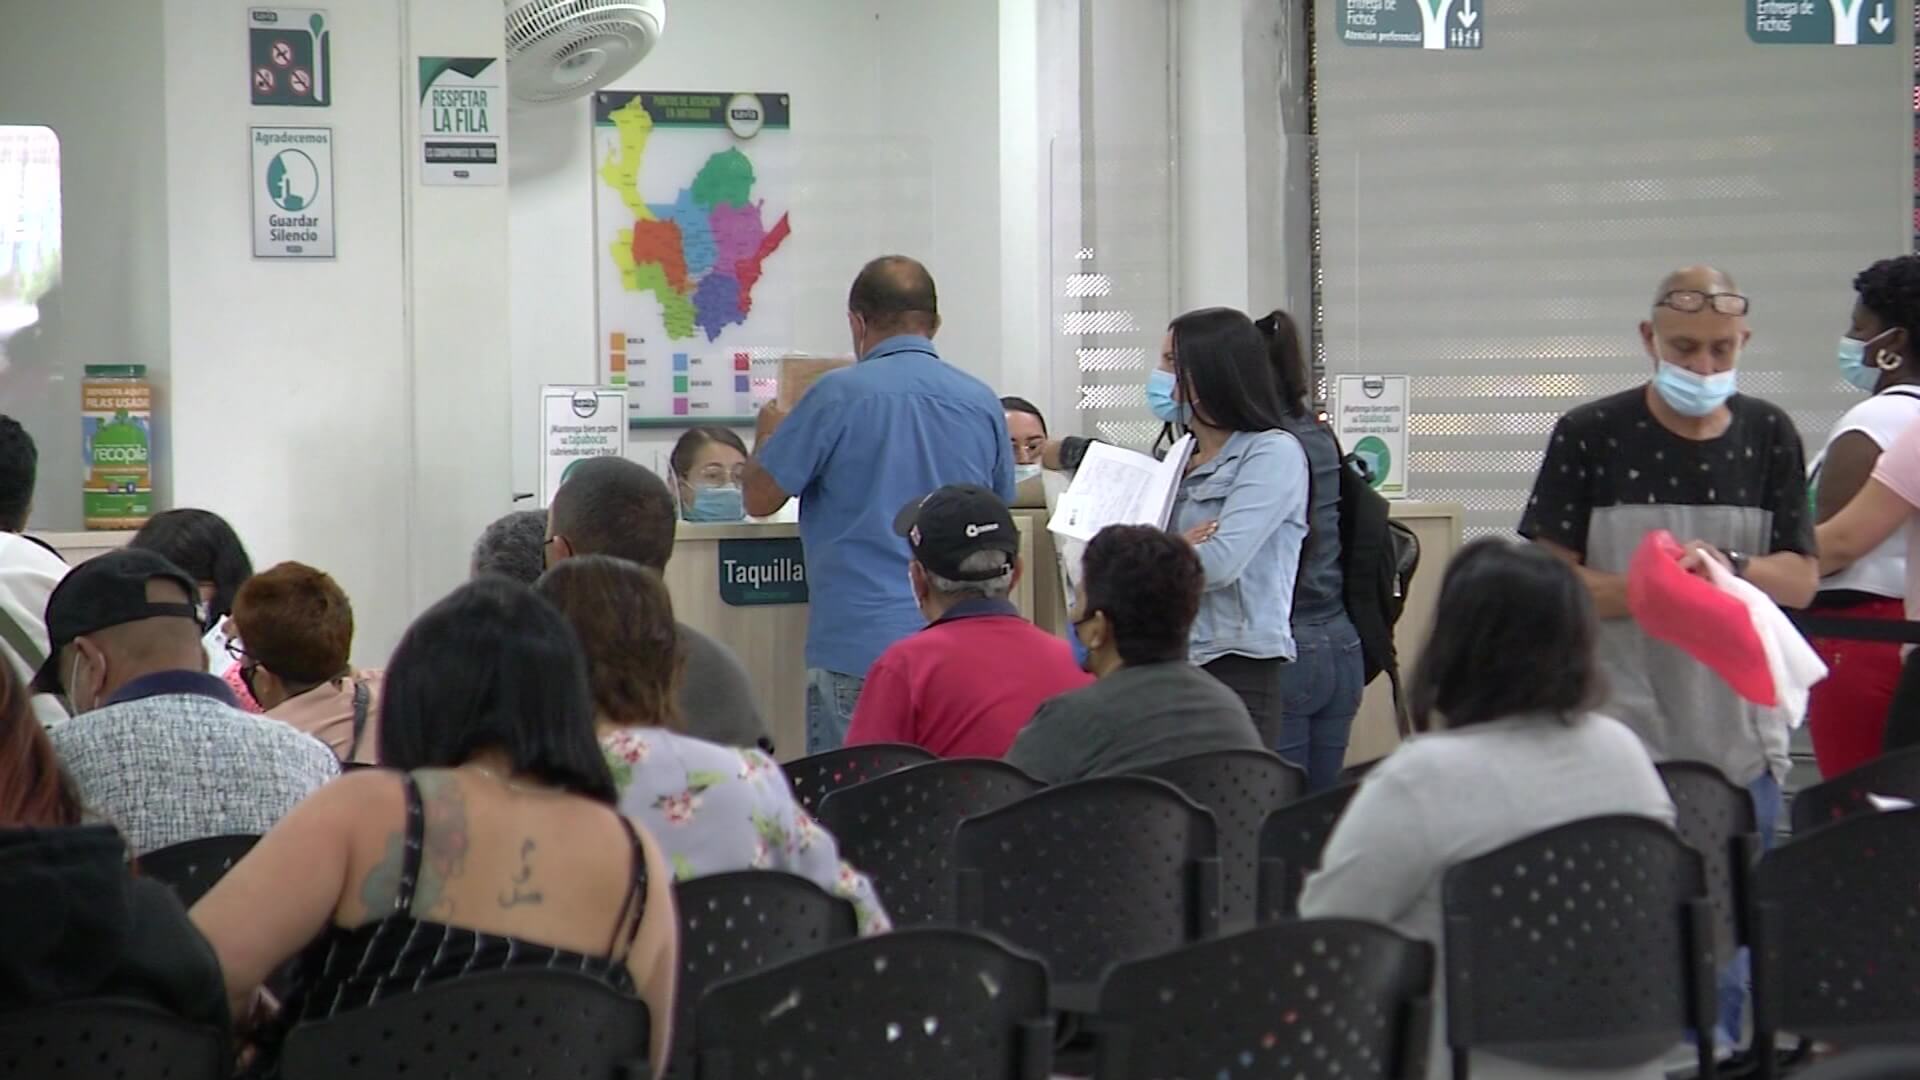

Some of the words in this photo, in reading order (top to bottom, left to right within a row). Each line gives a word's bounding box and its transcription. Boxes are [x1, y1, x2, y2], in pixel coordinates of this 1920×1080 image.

[1756, 0, 1799, 16] Entrega
[1800, 1, 1815, 15] de
[1347, 10, 1377, 25] Fichos
[1756, 15, 1792, 31] Fichos
[1344, 29, 1377, 40] Atención
[1379, 30, 1422, 43] preferencial
[432, 89, 488, 107] RESPETAR
[432, 107, 452, 133] LA
[455, 108, 489, 133] FILA
[255, 131, 328, 146] Agradecemos
[269, 214, 319, 227] Guardar
[269, 228, 318, 241] Silencio
[569, 435, 608, 446] tapabocas
[723, 558, 804, 590] Taquilla
